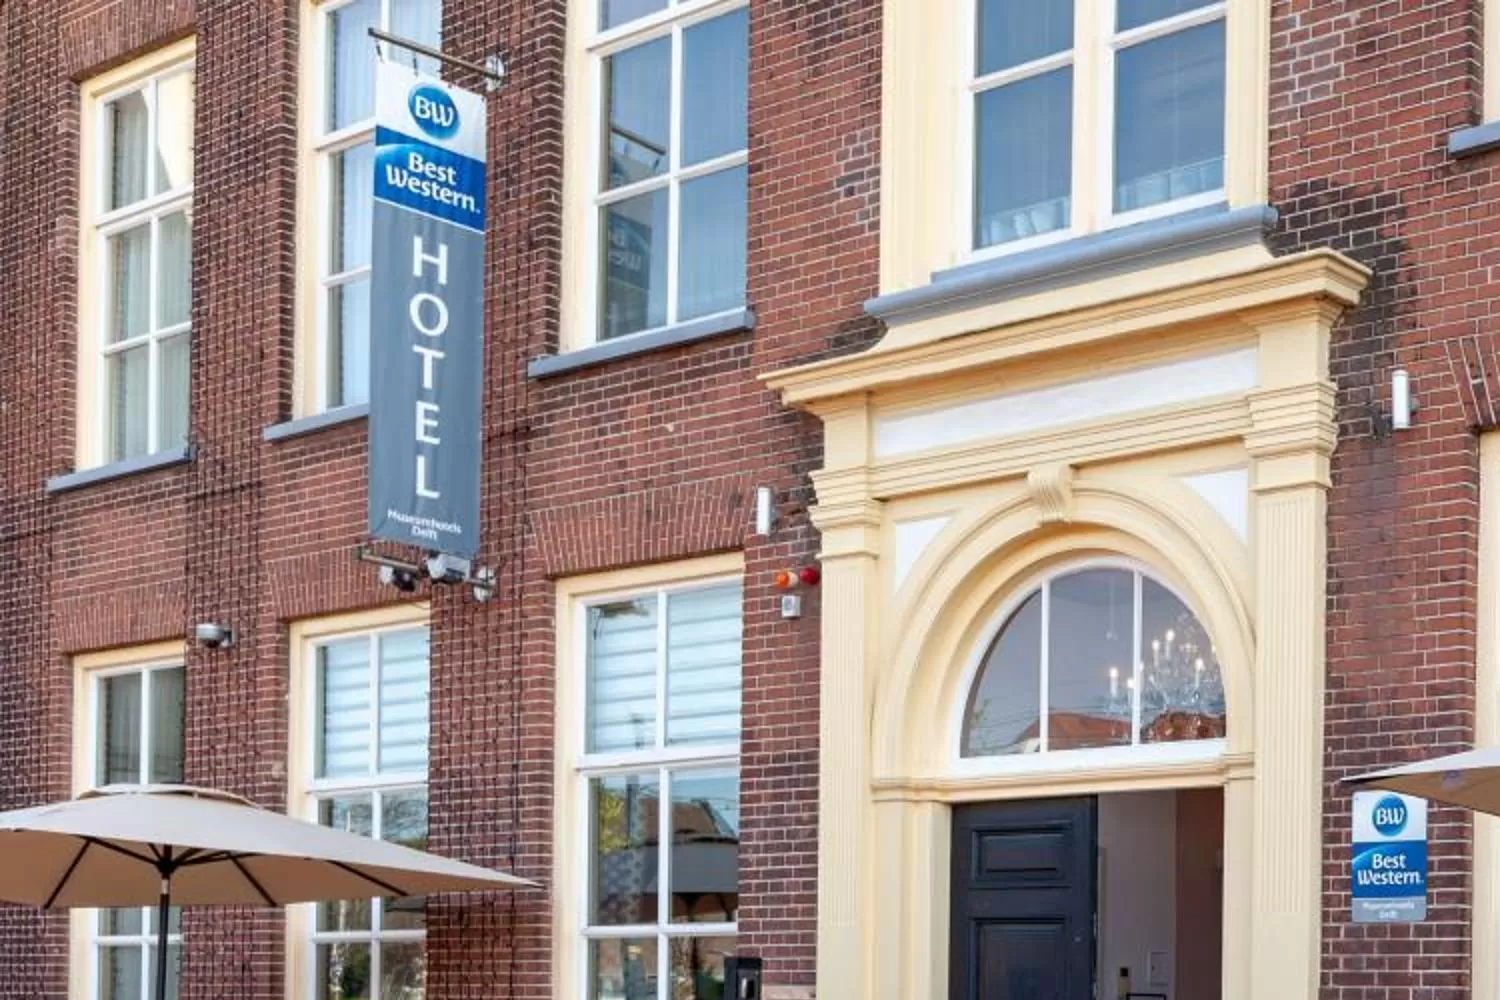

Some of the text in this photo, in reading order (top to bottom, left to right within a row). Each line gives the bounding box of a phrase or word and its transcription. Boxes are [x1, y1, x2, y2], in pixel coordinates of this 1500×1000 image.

[415, 96, 453, 126] BW
[408, 151, 456, 185] Best
[409, 235, 449, 500] HOTEL
[1377, 807, 1404, 825] BW
[1372, 853, 1407, 869] Best
